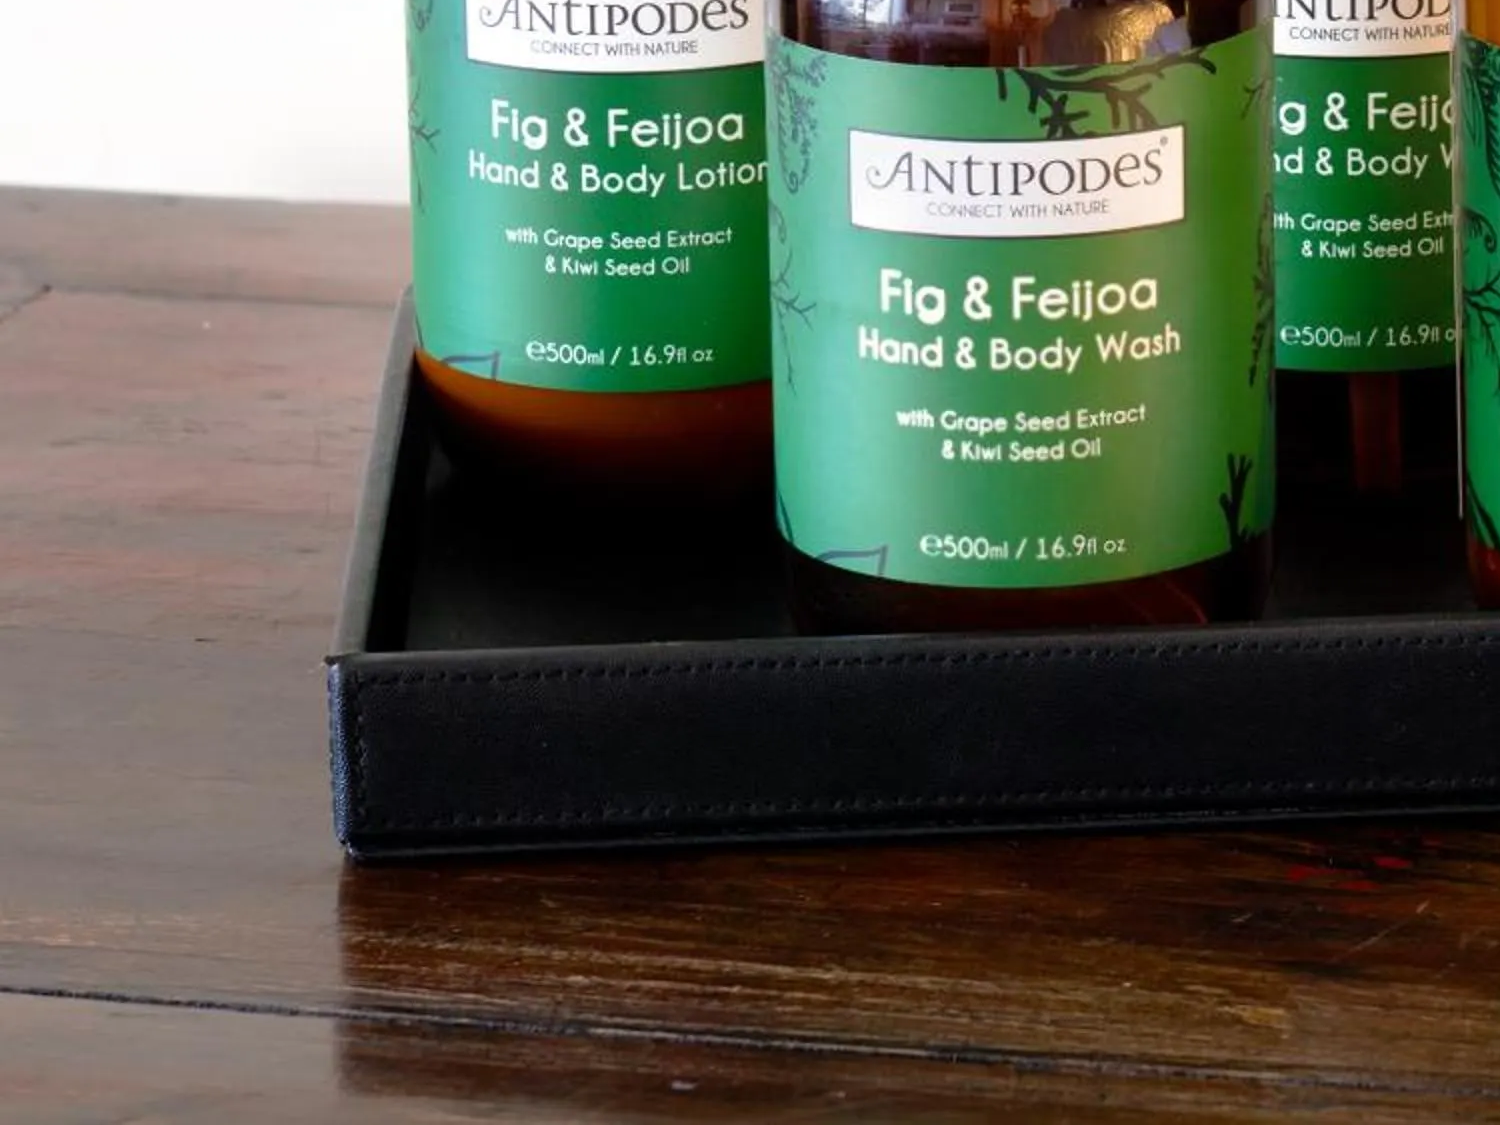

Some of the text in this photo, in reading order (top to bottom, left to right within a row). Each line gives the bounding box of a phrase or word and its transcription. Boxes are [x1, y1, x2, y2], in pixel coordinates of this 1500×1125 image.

[1289, 26, 1359, 41] CONNECT
[1365, 26, 1399, 41] WITH
[531, 40, 698, 56] CONNECT WITH NATURE
[491, 99, 743, 150] Fig & Feijoa
[1323, 91, 1350, 132] &
[1367, 92, 1453, 133] Feij
[468, 150, 539, 189] Hand
[551, 162, 569, 192] &
[581, 162, 665, 198] Body
[1315, 147, 1333, 175] &
[1347, 146, 1428, 179] Body
[926, 199, 1110, 218] CONNECT WITH NATURE
[1273, 212, 1295, 230] ith
[1301, 213, 1361, 237] Grape
[1367, 213, 1417, 232] Seed
[505, 227, 733, 253] with Grape Seed Extract
[1301, 236, 1444, 258] & Kiwi Seed Oil
[545, 255, 690, 275] & Kiwi Seed Oil
[880, 268, 1158, 324] Fig & Feijoa
[1444, 329, 1456, 342] o
[692, 347, 715, 363] oz
[859, 325, 1181, 373] Hand & Body Wash
[896, 404, 1146, 437] with Grape Seed Extract
[941, 437, 1101, 461] & Kiwi Seed Oil
[1035, 533, 1097, 560] 16.9fl
[1103, 538, 1127, 554] oz
